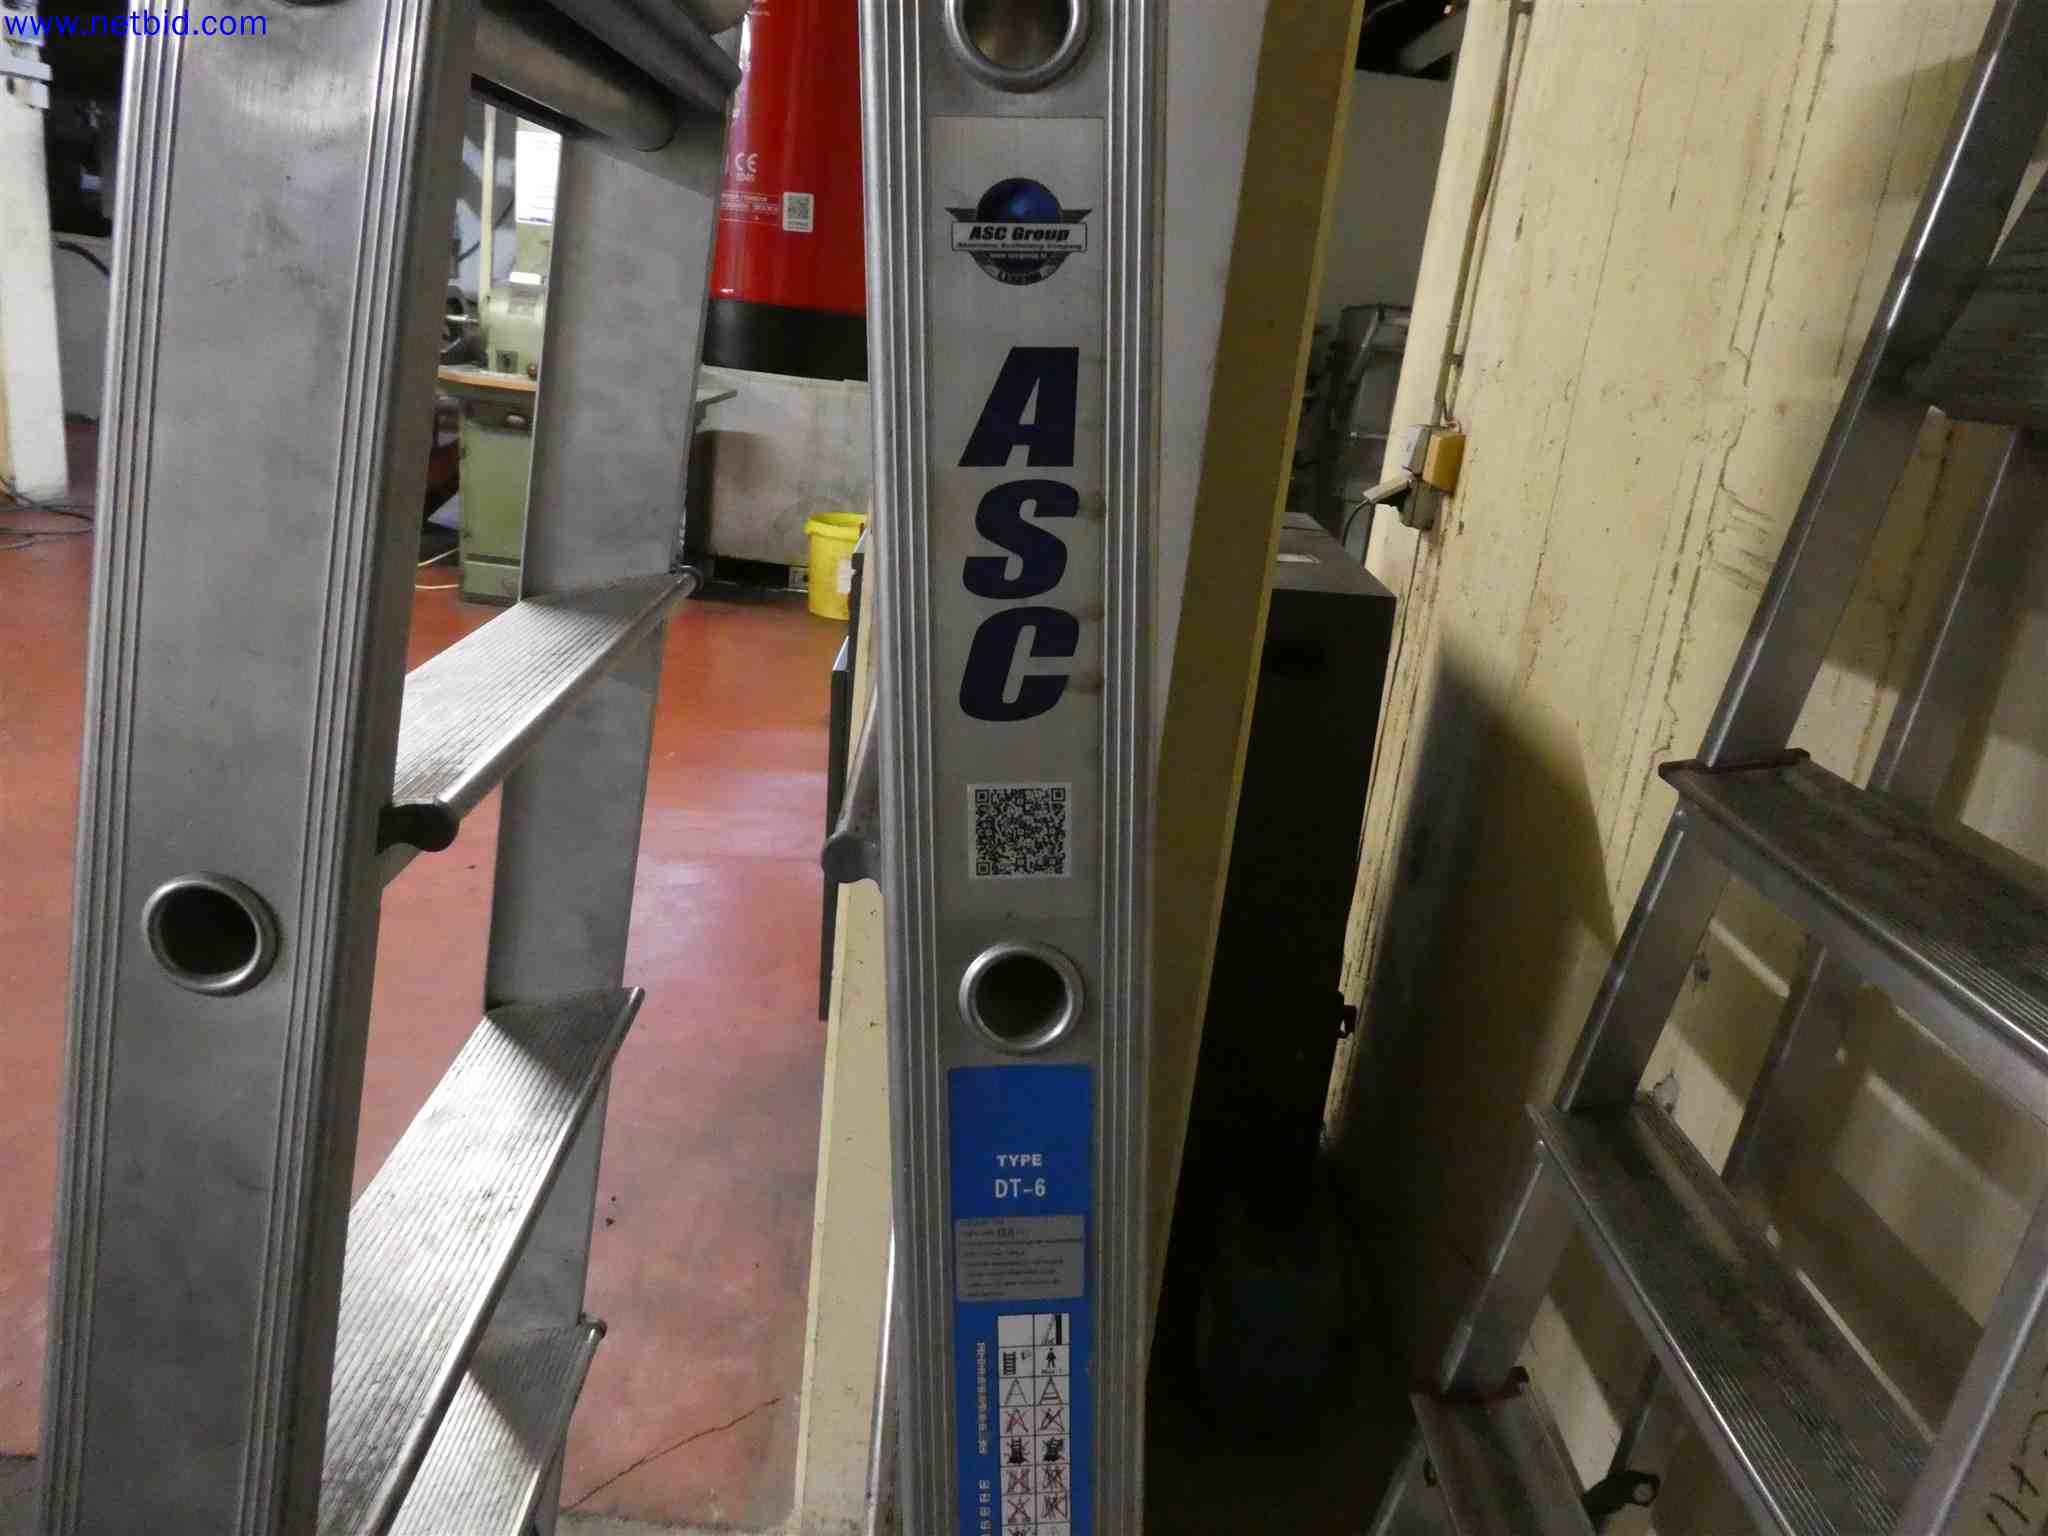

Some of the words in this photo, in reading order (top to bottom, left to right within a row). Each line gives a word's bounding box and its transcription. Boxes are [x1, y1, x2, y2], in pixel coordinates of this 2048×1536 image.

[969, 226, 1007, 241] ASC
[1011, 227, 1071, 243] Group
[958, 347, 1079, 721] ASC
[996, 1154, 1043, 1167] TYPE
[994, 1178, 1046, 1199] DT-6
